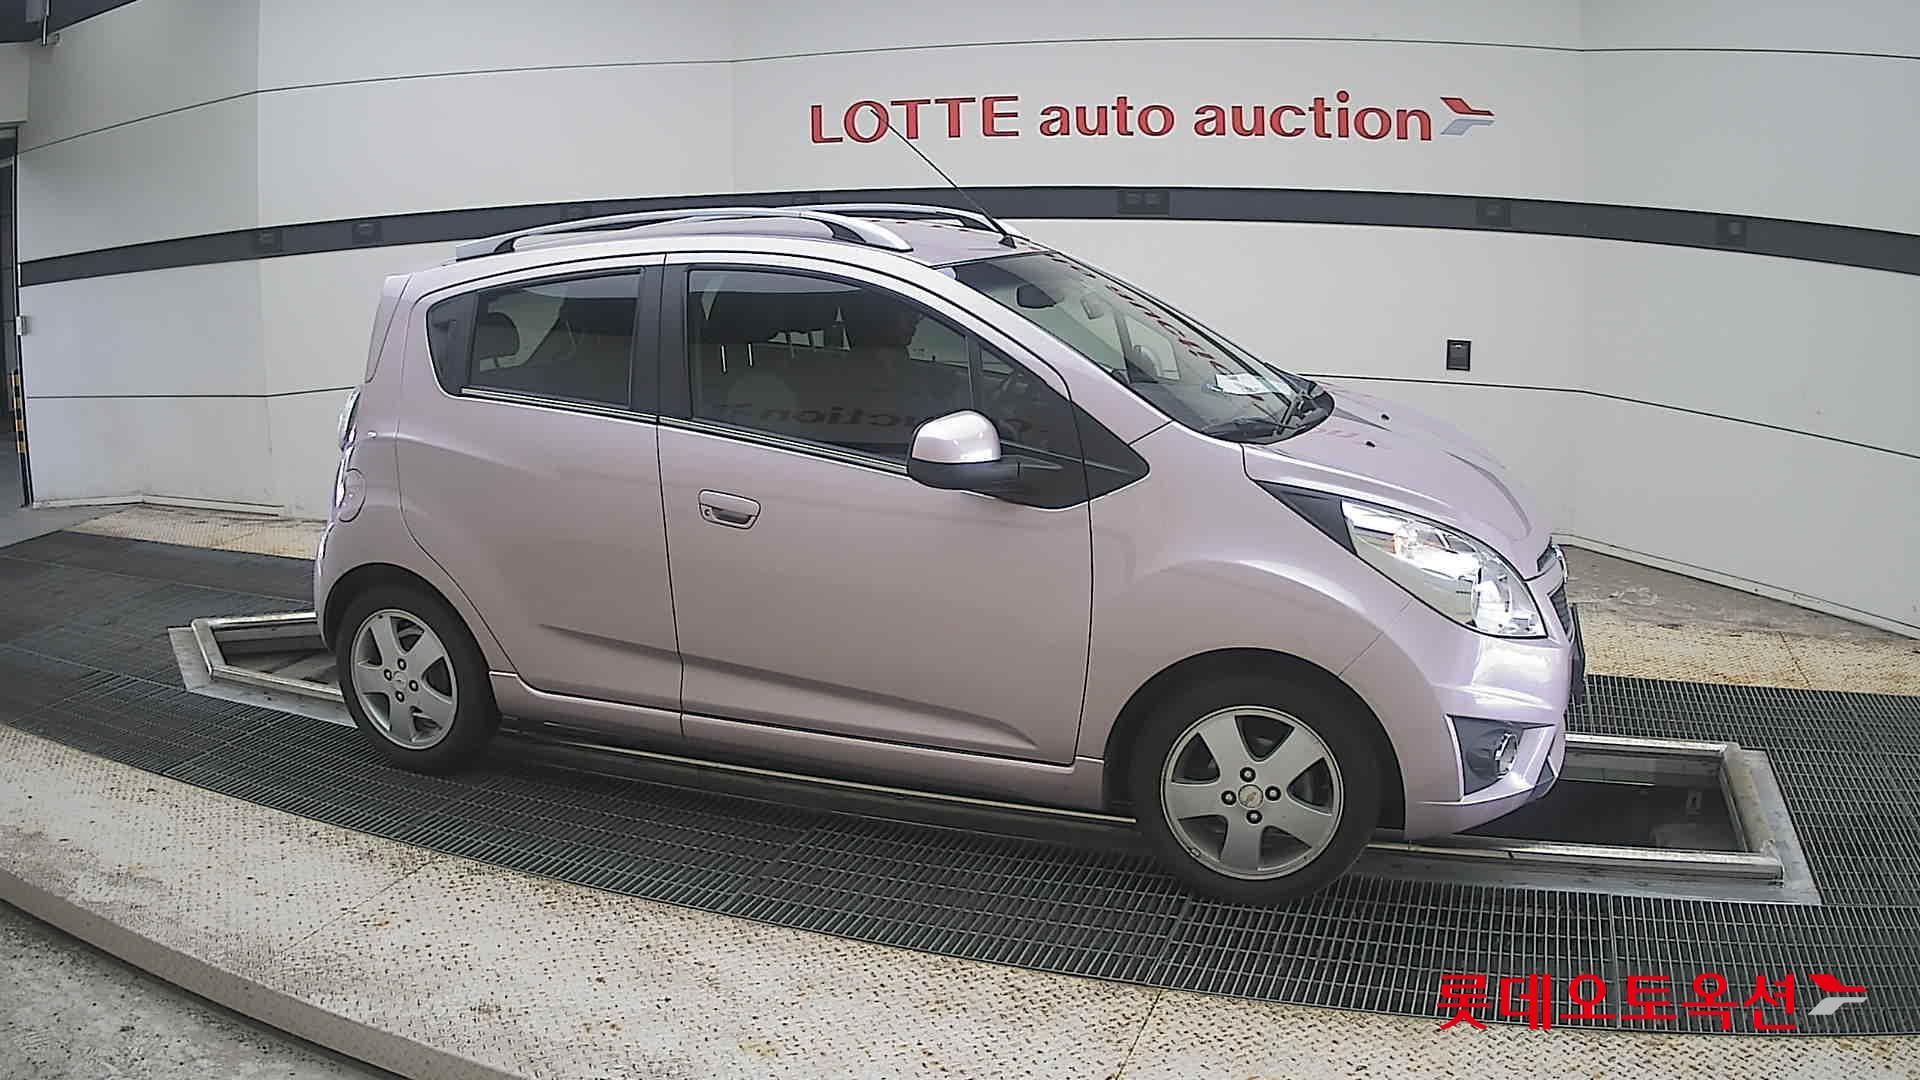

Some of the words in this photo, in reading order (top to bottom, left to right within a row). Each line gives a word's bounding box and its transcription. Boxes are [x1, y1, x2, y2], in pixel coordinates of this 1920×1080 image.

[810, 95, 1019, 143] LOTTE
[1039, 96, 1175, 137] auto
[1194, 90, 1432, 141] auction
